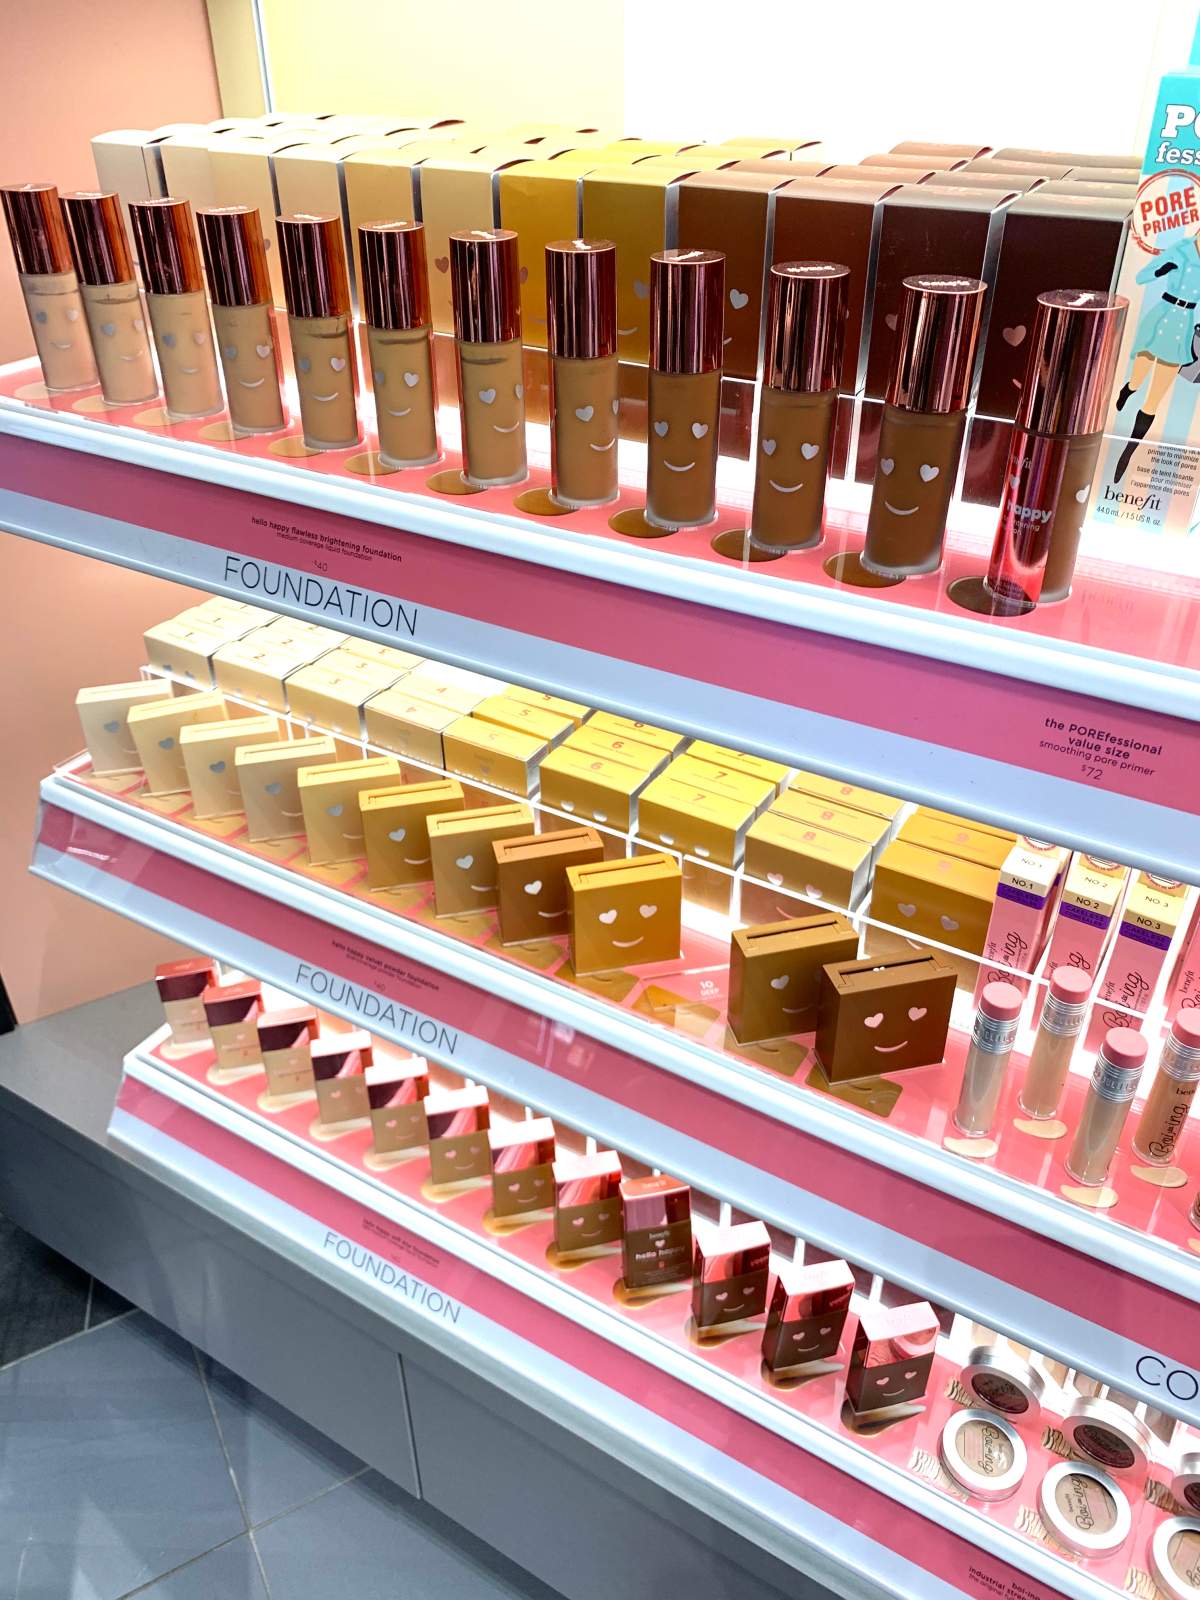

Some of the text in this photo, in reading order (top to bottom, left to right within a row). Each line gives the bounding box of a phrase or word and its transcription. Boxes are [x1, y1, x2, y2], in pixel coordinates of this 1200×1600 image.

[1160, 104, 1200, 138] P
[1140, 186, 1197, 221] PORE
[1143, 208, 1200, 237] PRIMER
[1136, 466, 1151, 474] base
[1151, 467, 1158, 475] de
[1151, 456, 1197, 471] the look of pores
[1104, 485, 1162, 511] benefit
[1173, 488, 1190, 497] pores
[1135, 513, 1145, 523] US
[251, 516, 402, 563] hello happy flawless brightening foundation
[313, 559, 328, 572] $40
[224, 555, 418, 636] FOUNDATION
[519, 709, 531, 717] 5
[1044, 717, 1163, 756] the POREfessional
[611, 741, 624, 749] 6
[1068, 736, 1130, 760] value size
[1039, 739, 1156, 776] smoothing pore primer
[590, 762, 603, 770] 6
[1081, 764, 1104, 781] $72
[714, 771, 728, 779] 7
[692, 793, 707, 801] 7
[840, 786, 853, 796] 8
[821, 811, 834, 821] 8
[803, 831, 816, 841] 8
[296, 963, 458, 1055] FOUNDATION
[635, 1251, 657, 1261] hello
[324, 1231, 461, 1324] FOUNDATION
[1135, 1355, 1199, 1401] CO
[968, 1566, 1006, 1590] industrial
